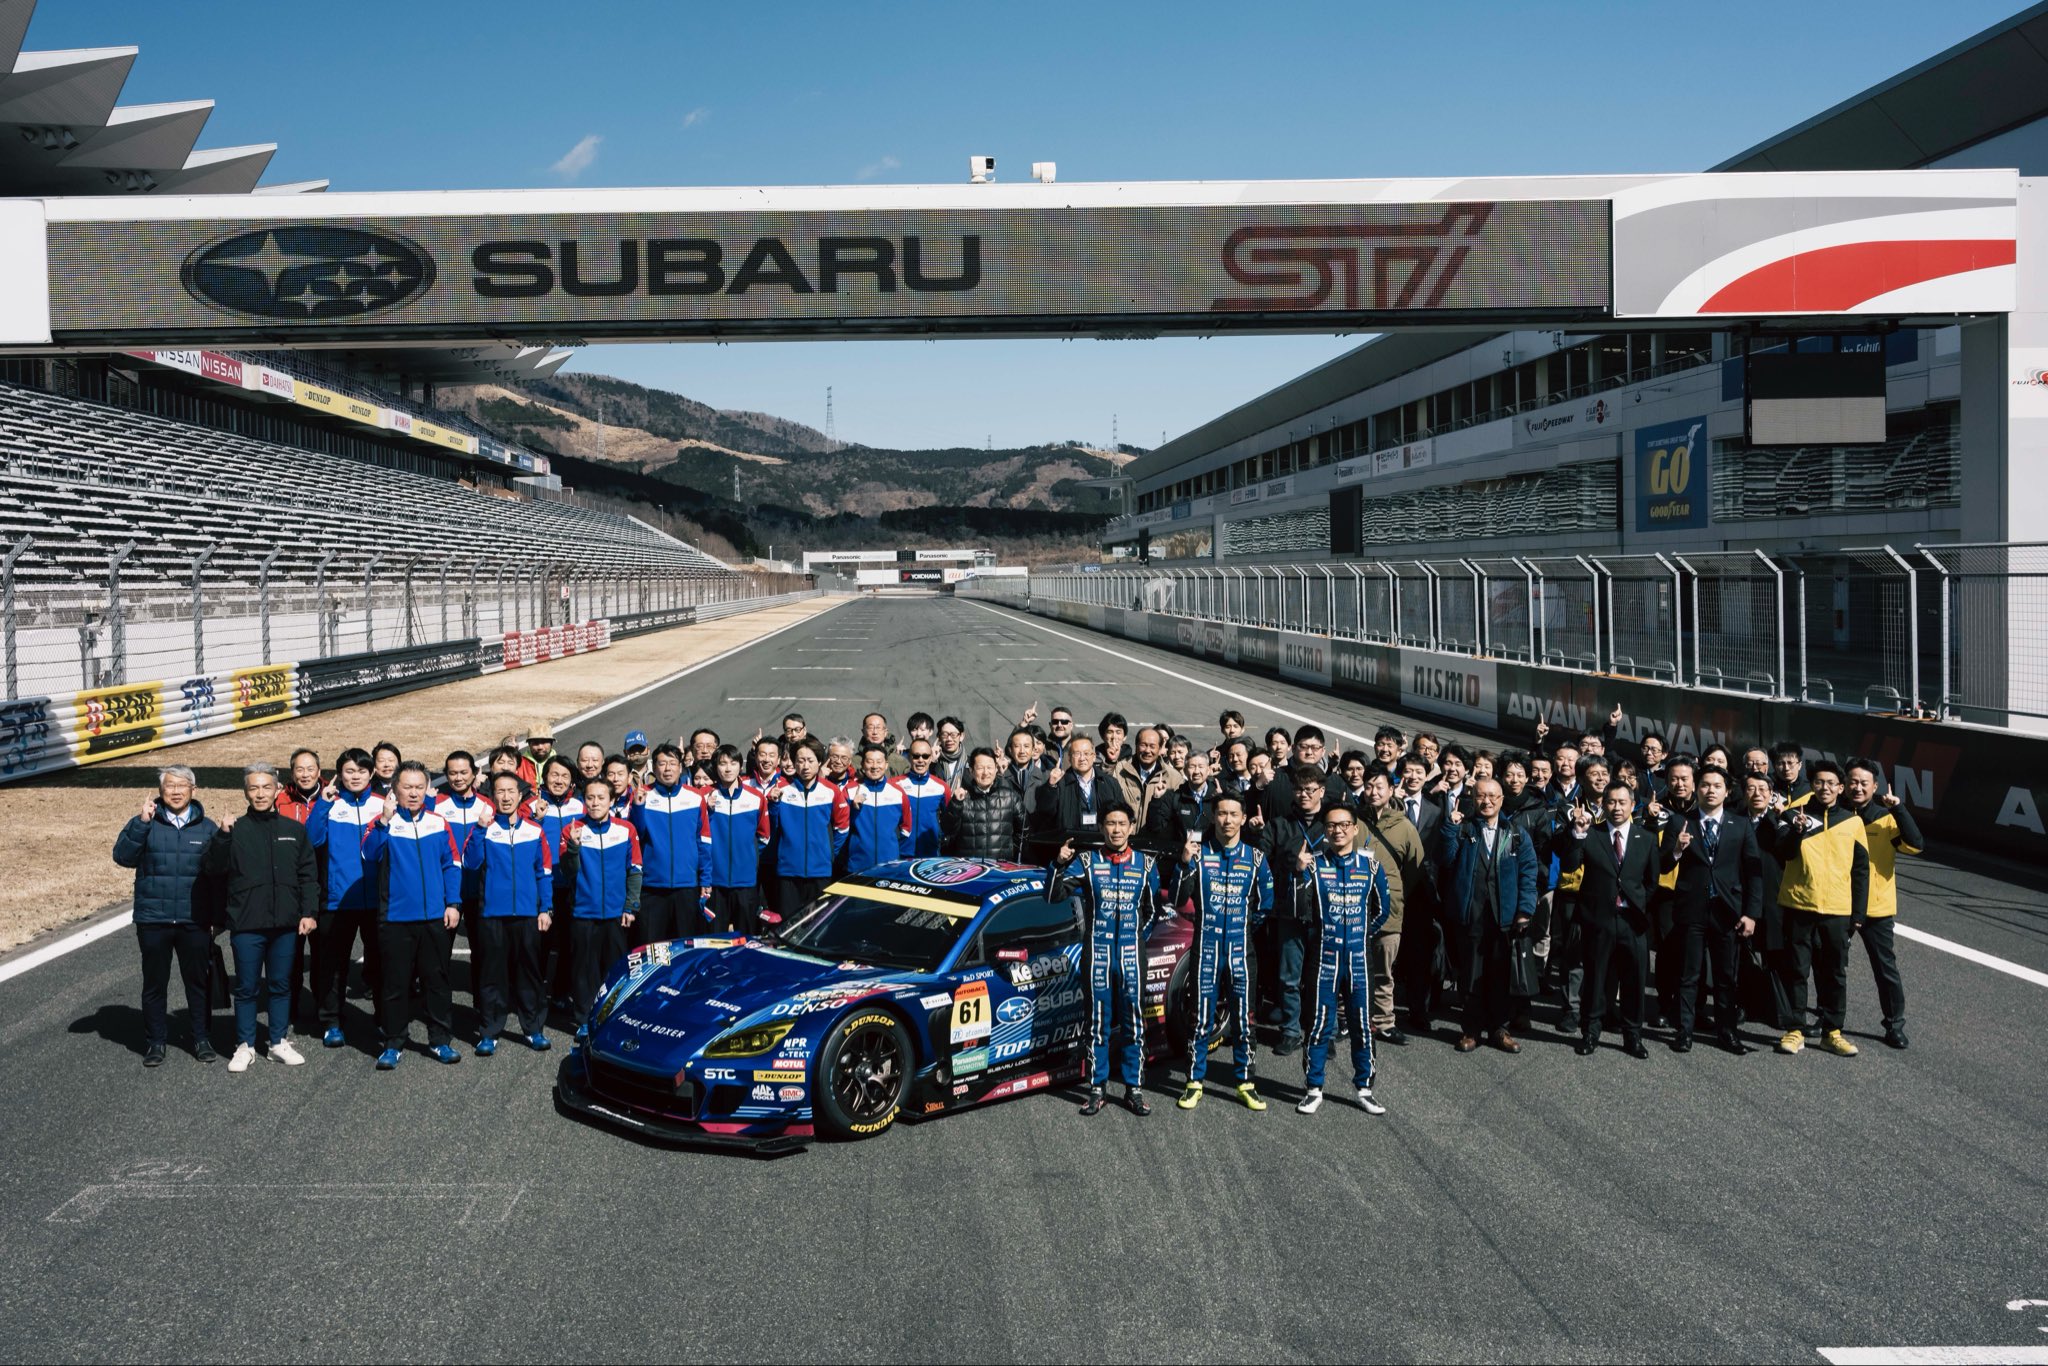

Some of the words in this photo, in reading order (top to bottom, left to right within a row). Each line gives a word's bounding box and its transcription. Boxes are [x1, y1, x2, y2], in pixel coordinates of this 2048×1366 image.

[472, 235, 981, 298] SUBARU
[202, 356, 241, 380] NISSAN
[269, 375, 293, 394] DAIHATSU
[308, 391, 331, 405] DUNLOP
[352, 404, 371, 418] DUNLOP
[421, 427, 436, 438] DUNLOP
[449, 435, 463, 446] DUNLOP
[1651, 446, 1690, 494] GO
[1650, 501, 1690, 519] GOODYEAR
[1507, 692, 1586, 731] ADVAN
[889, 882, 932, 895] SUBARU
[1101, 901, 1134, 910] DENSO
[1210, 895, 1242, 905] DENSO
[1328, 905, 1362, 915] DENSO
[976, 970, 994, 979] SPORT
[1009, 954, 1069, 984] KeePer
[1147, 968, 1170, 980] STC
[956, 986, 986, 996] AUTOBACS
[1018, 985, 1029, 993] FOR
[1038, 987, 1085, 1012] SUBA
[771, 999, 848, 1016] DENSO
[960, 998, 980, 1024] 61
[850, 1015, 895, 1031] DUNLOP
[651, 1025, 686, 1039] BOXER
[1052, 1021, 1085, 1044] DEN
[784, 1038, 807, 1048] NPR
[778, 1050, 811, 1058] G-TEKT
[953, 1052, 985, 1066] Panasonic
[774, 1060, 804, 1068] MOTUL
[987, 1062, 1014, 1074] SUBARU
[704, 1068, 736, 1080] STC
[752, 1084, 773, 1095] MAC
[850, 1110, 894, 1132] DUNLOP
